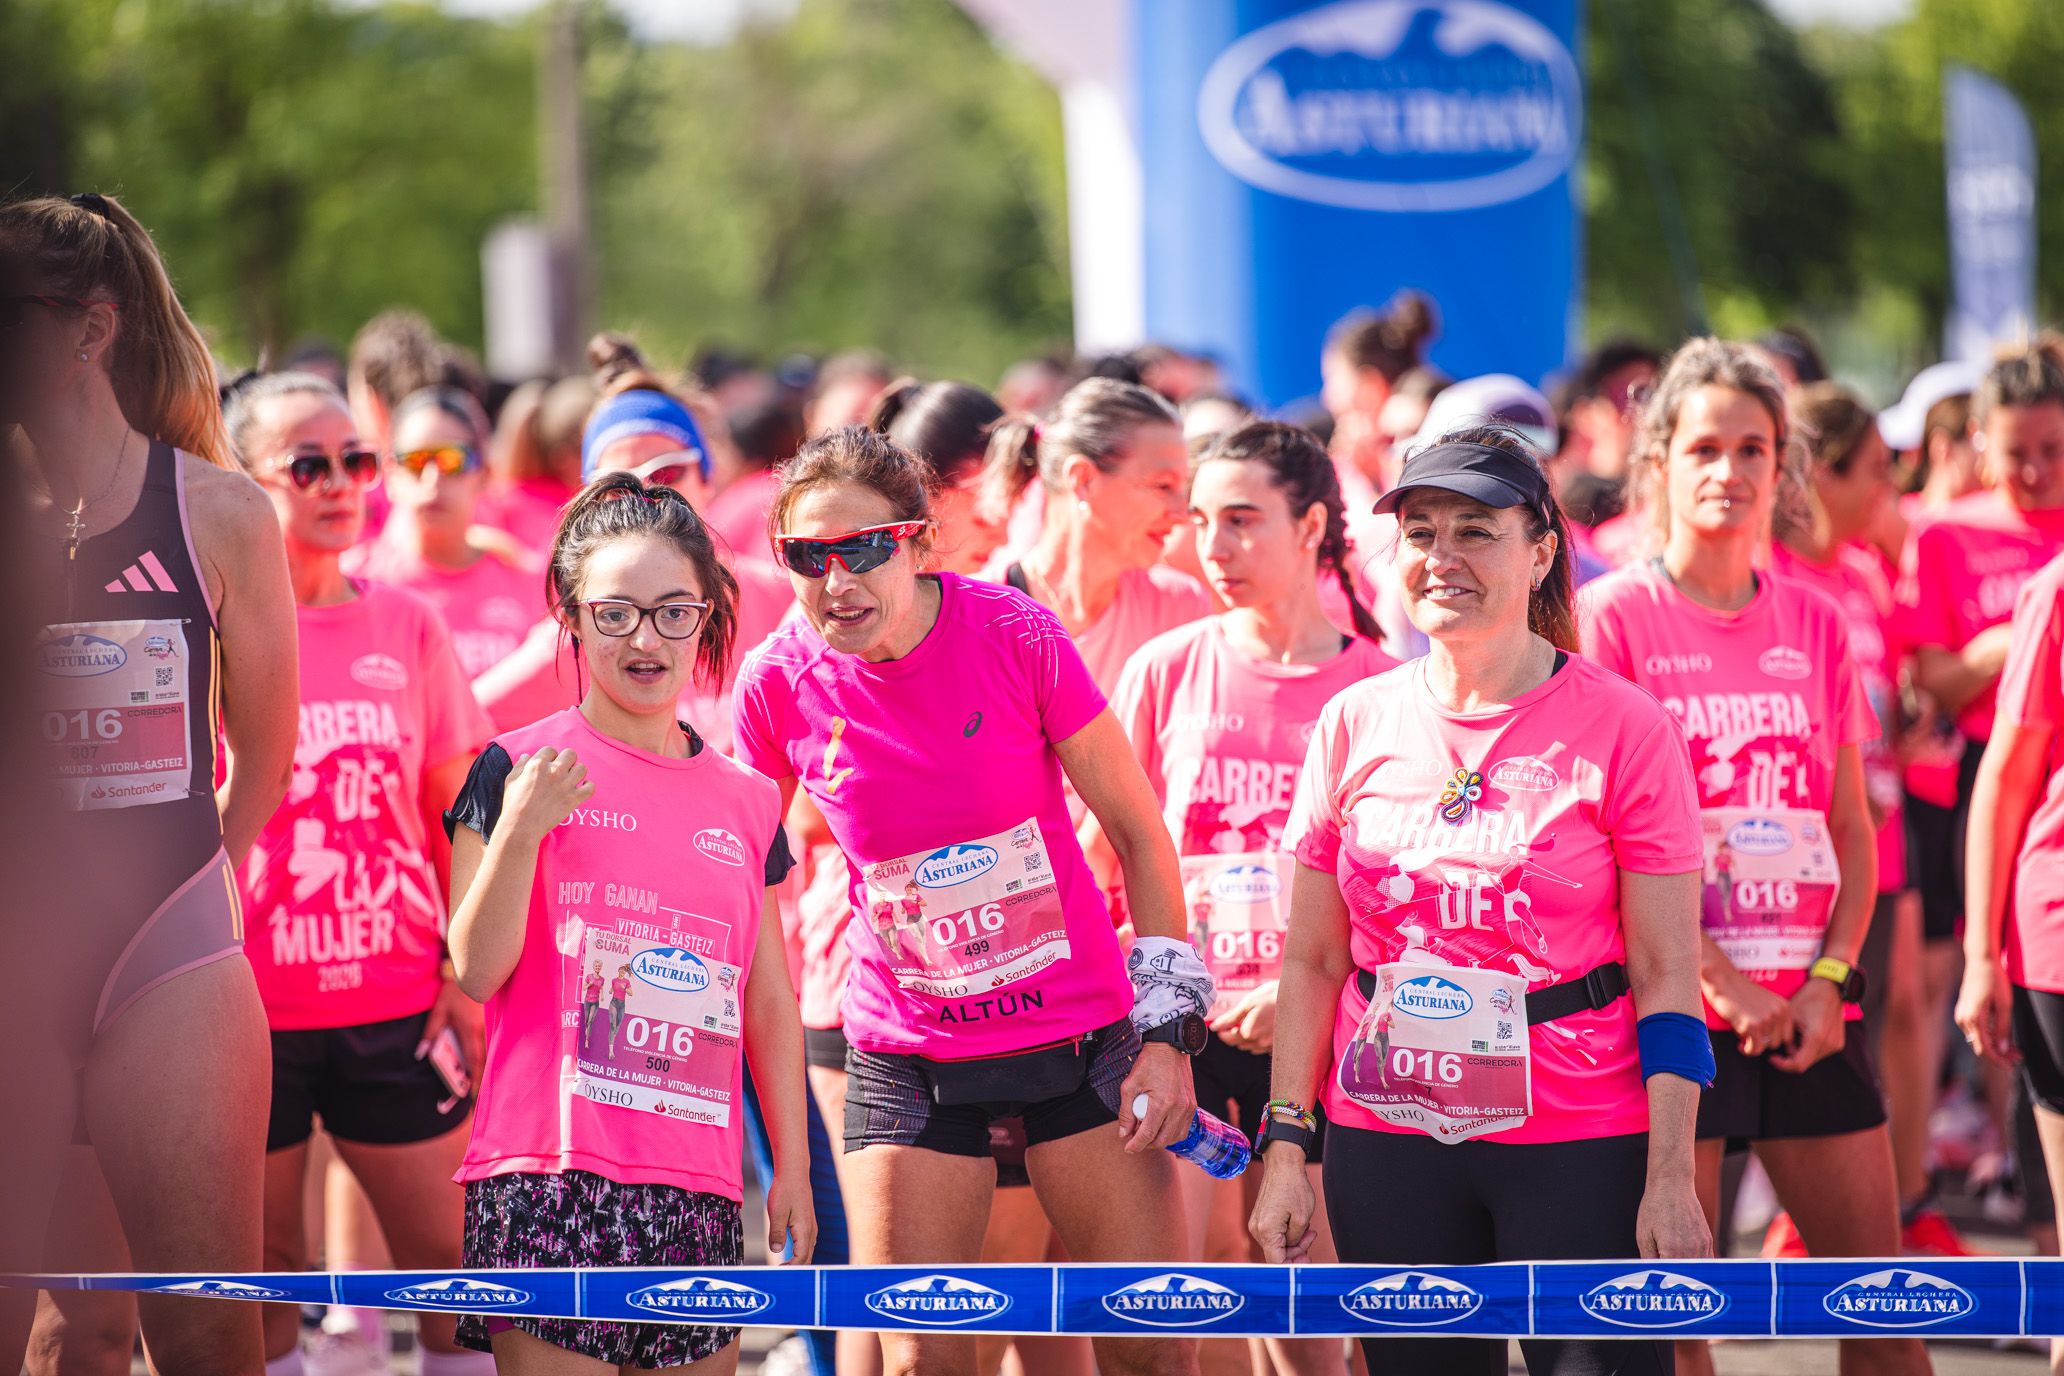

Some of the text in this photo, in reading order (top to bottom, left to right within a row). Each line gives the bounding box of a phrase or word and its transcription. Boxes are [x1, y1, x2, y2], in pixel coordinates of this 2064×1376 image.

[43, 709, 124, 742] 016
[101, 757, 184, 773] VITORIA-GASTEIZ
[1493, 766, 1553, 787] ASTURIANA
[108, 781, 167, 798] Santander
[698, 834, 743, 863] ASTURIANA
[873, 863, 911, 881] SUMA
[922, 855, 994, 883] ASTURIANA
[557, 882, 659, 915] HOY GANAN
[1005, 886, 1057, 906] CORREDORA
[1735, 879, 1799, 909] 016
[932, 903, 1005, 946] 016
[272, 909, 396, 966] MUJER
[595, 939, 630, 956] SUMA
[618, 920, 660, 942] VITORIA
[670, 931, 714, 955] GASTEIZ
[1212, 930, 1280, 960] 016
[892, 930, 1067, 978] CARRERA DE LA MUJER VITORIA-GASTEIZ
[964, 940, 990, 957] 499
[636, 956, 705, 986] ASTURIANA
[1005, 952, 1058, 983] Santander
[912, 981, 968, 997] OYSHO
[1397, 989, 1466, 1010] ASTURIANA
[940, 990, 1043, 1024] ALTÚN
[626, 1016, 695, 1057] 016
[698, 1032, 739, 1049] CORREDORA
[646, 1057, 670, 1073] 500
[1393, 1049, 1463, 1083] 016
[1467, 1057, 1523, 1067] CORREDORA
[577, 1058, 731, 1102] CARRERA DE LA MUJER VITORIA-GASTEIZ
[585, 1083, 633, 1107] OYSHO
[1349, 1090, 1525, 1116] CARRERA DE LA MUJER VITORIA-GASTEIZ
[668, 1104, 716, 1123] Santander
[1377, 1108, 1425, 1123] YSHO
[395, 1290, 518, 1303] ASTURIANA
[636, 1292, 759, 1308] ASTURIANA
[875, 1293, 998, 1310] ASTURIANA
[1113, 1295, 1233, 1310] ASTURIANA
[1351, 1294, 1473, 1310] ASTURIANA
[1590, 1294, 1714, 1311] ASTURIANA
[1833, 1293, 1961, 1312] ASTURIANA
